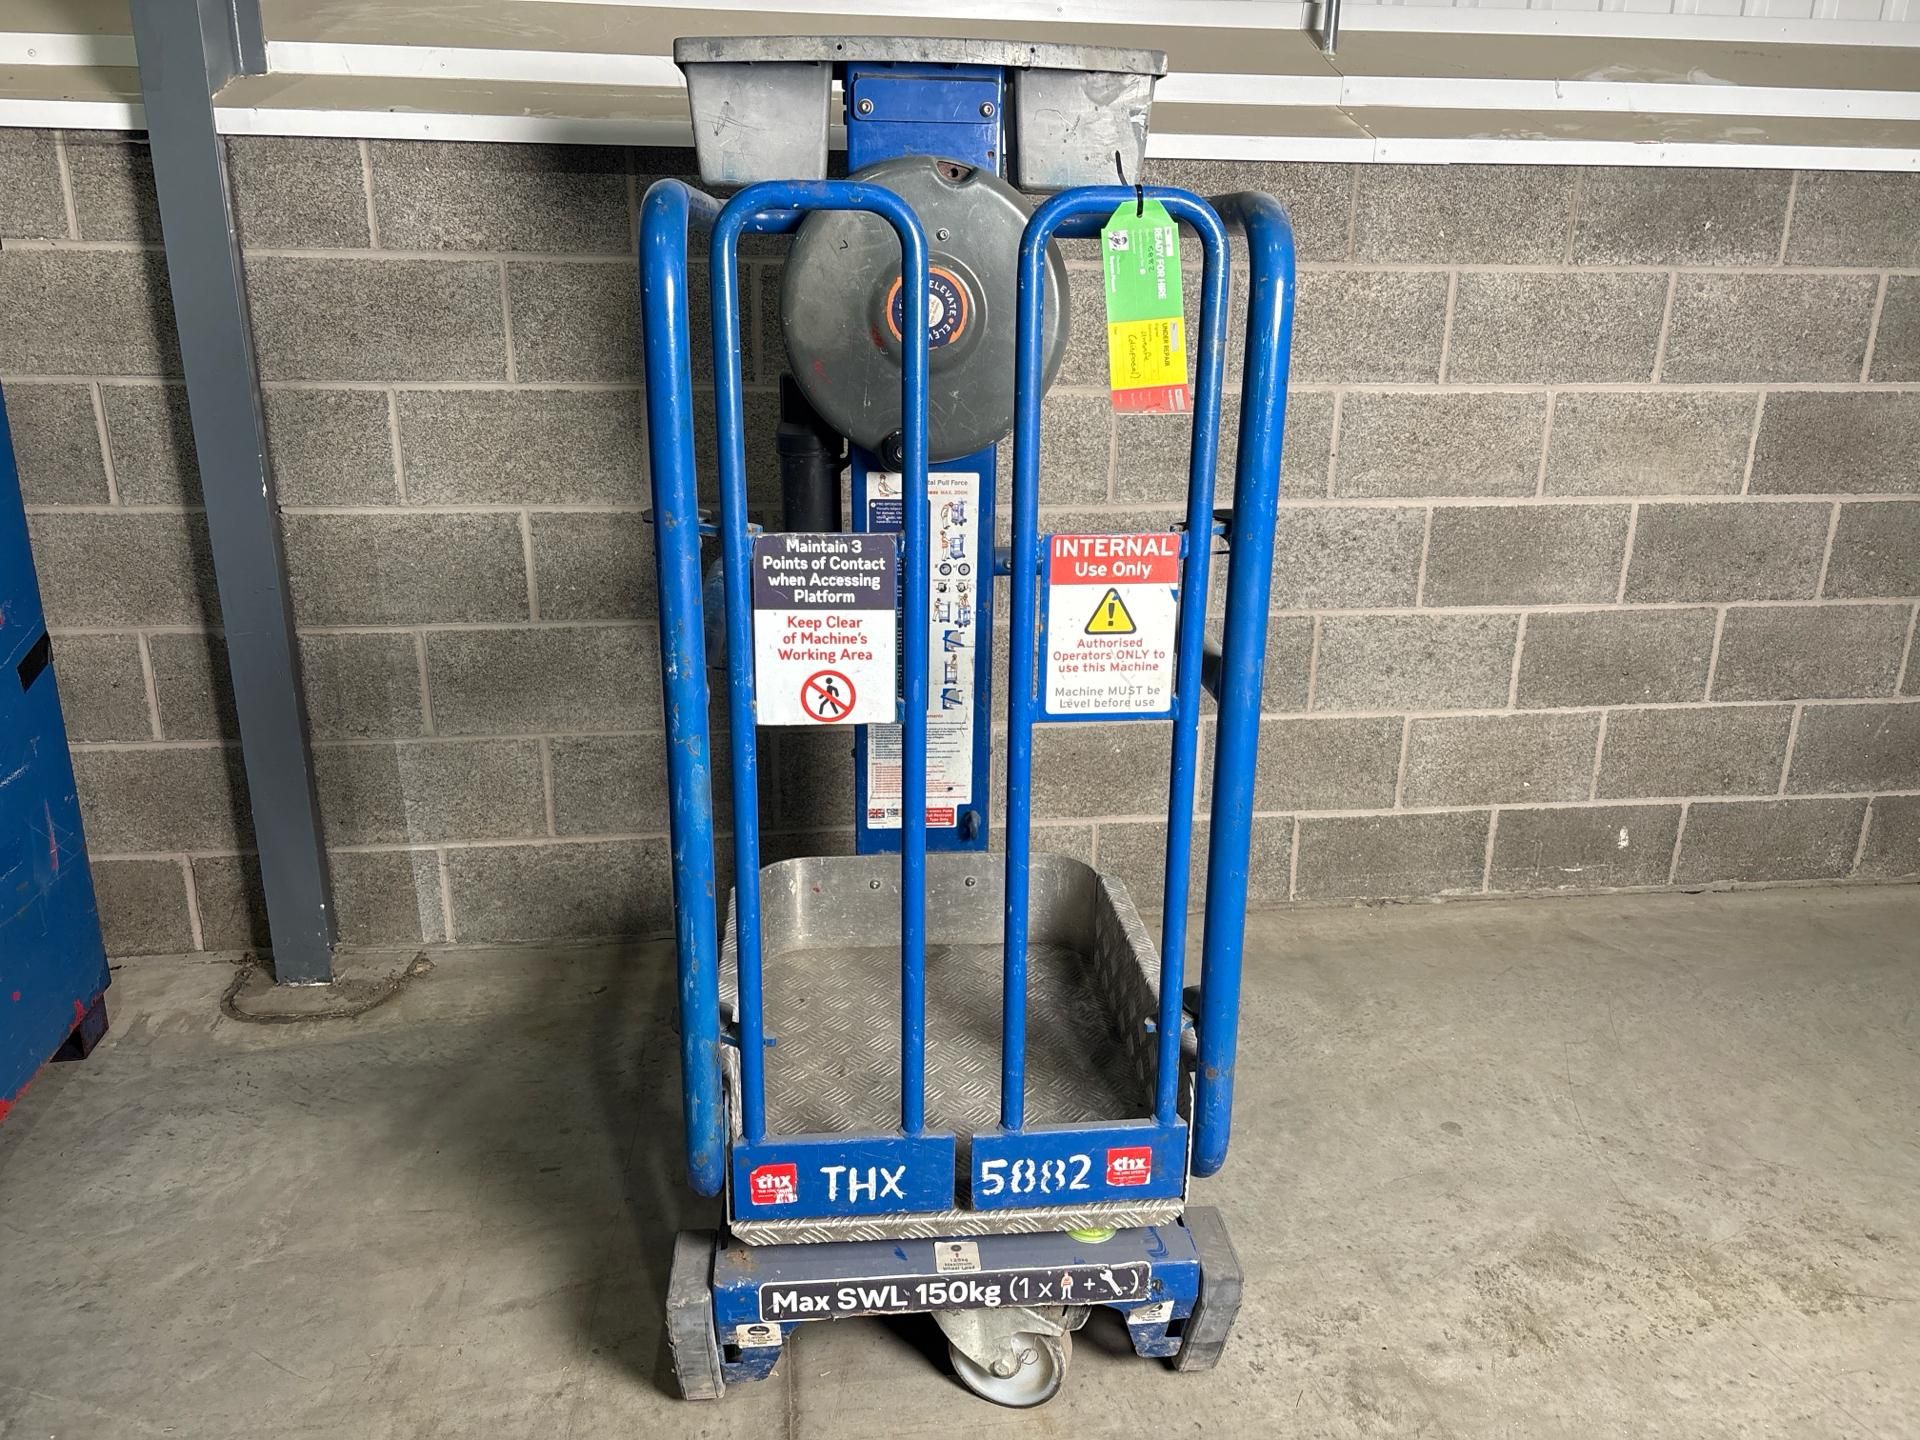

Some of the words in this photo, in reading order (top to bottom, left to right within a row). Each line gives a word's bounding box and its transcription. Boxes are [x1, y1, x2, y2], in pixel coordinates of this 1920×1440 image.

[1154, 227, 1164, 257] READY
[1156, 258, 1166, 278] FOR
[1157, 279, 1167, 300] HIRE
[929, 280, 957, 317] ELEVATE
[1163, 345, 1171, 367] REPAIR
[786, 539, 849, 553] Maintain
[851, 540, 862, 553] 3
[1055, 538, 1173, 557] INTERNAL
[762, 556, 808, 570] Points
[811, 556, 826, 570] of
[829, 556, 886, 571] Contact
[1075, 562, 1108, 577] Use
[1112, 561, 1152, 579] Only
[768, 573, 807, 587] when
[809, 573, 881, 590] Accessing
[794, 589, 856, 603] Platform
[787, 615, 822, 631] Keep
[825, 615, 863, 629] Clear
[783, 632, 797, 645] of
[801, 632, 867, 645] Machine's
[1077, 638, 1143, 649] Authorised
[778, 649, 836, 663] Working
[840, 649, 873, 661] Area
[1053, 650, 1111, 662] Operators
[1116, 649, 1149, 660] ONLY
[1154, 649, 1165, 660] to
[1058, 664, 1078, 673] use
[1083, 663, 1106, 673] this
[1110, 661, 1159, 672] Machine
[1055, 687, 1104, 698] Machine
[1108, 686, 1143, 696] MUST
[1147, 685, 1160, 695] be
[1059, 697, 1090, 709] Level
[1094, 697, 1130, 708] before
[1134, 698, 1155, 707] use
[1112, 1156, 1147, 1171] thx
[755, 1174, 792, 1189] thx
[981, 1154, 1092, 1196] 5882
[820, 1165, 907, 1203] THX
[772, 1290, 830, 1314] Max
[837, 1285, 908, 1310] SWL
[915, 1280, 1000, 1307] 150kg
[1009, 1276, 1029, 1301] (1
[1038, 1282, 1053, 1298] x
